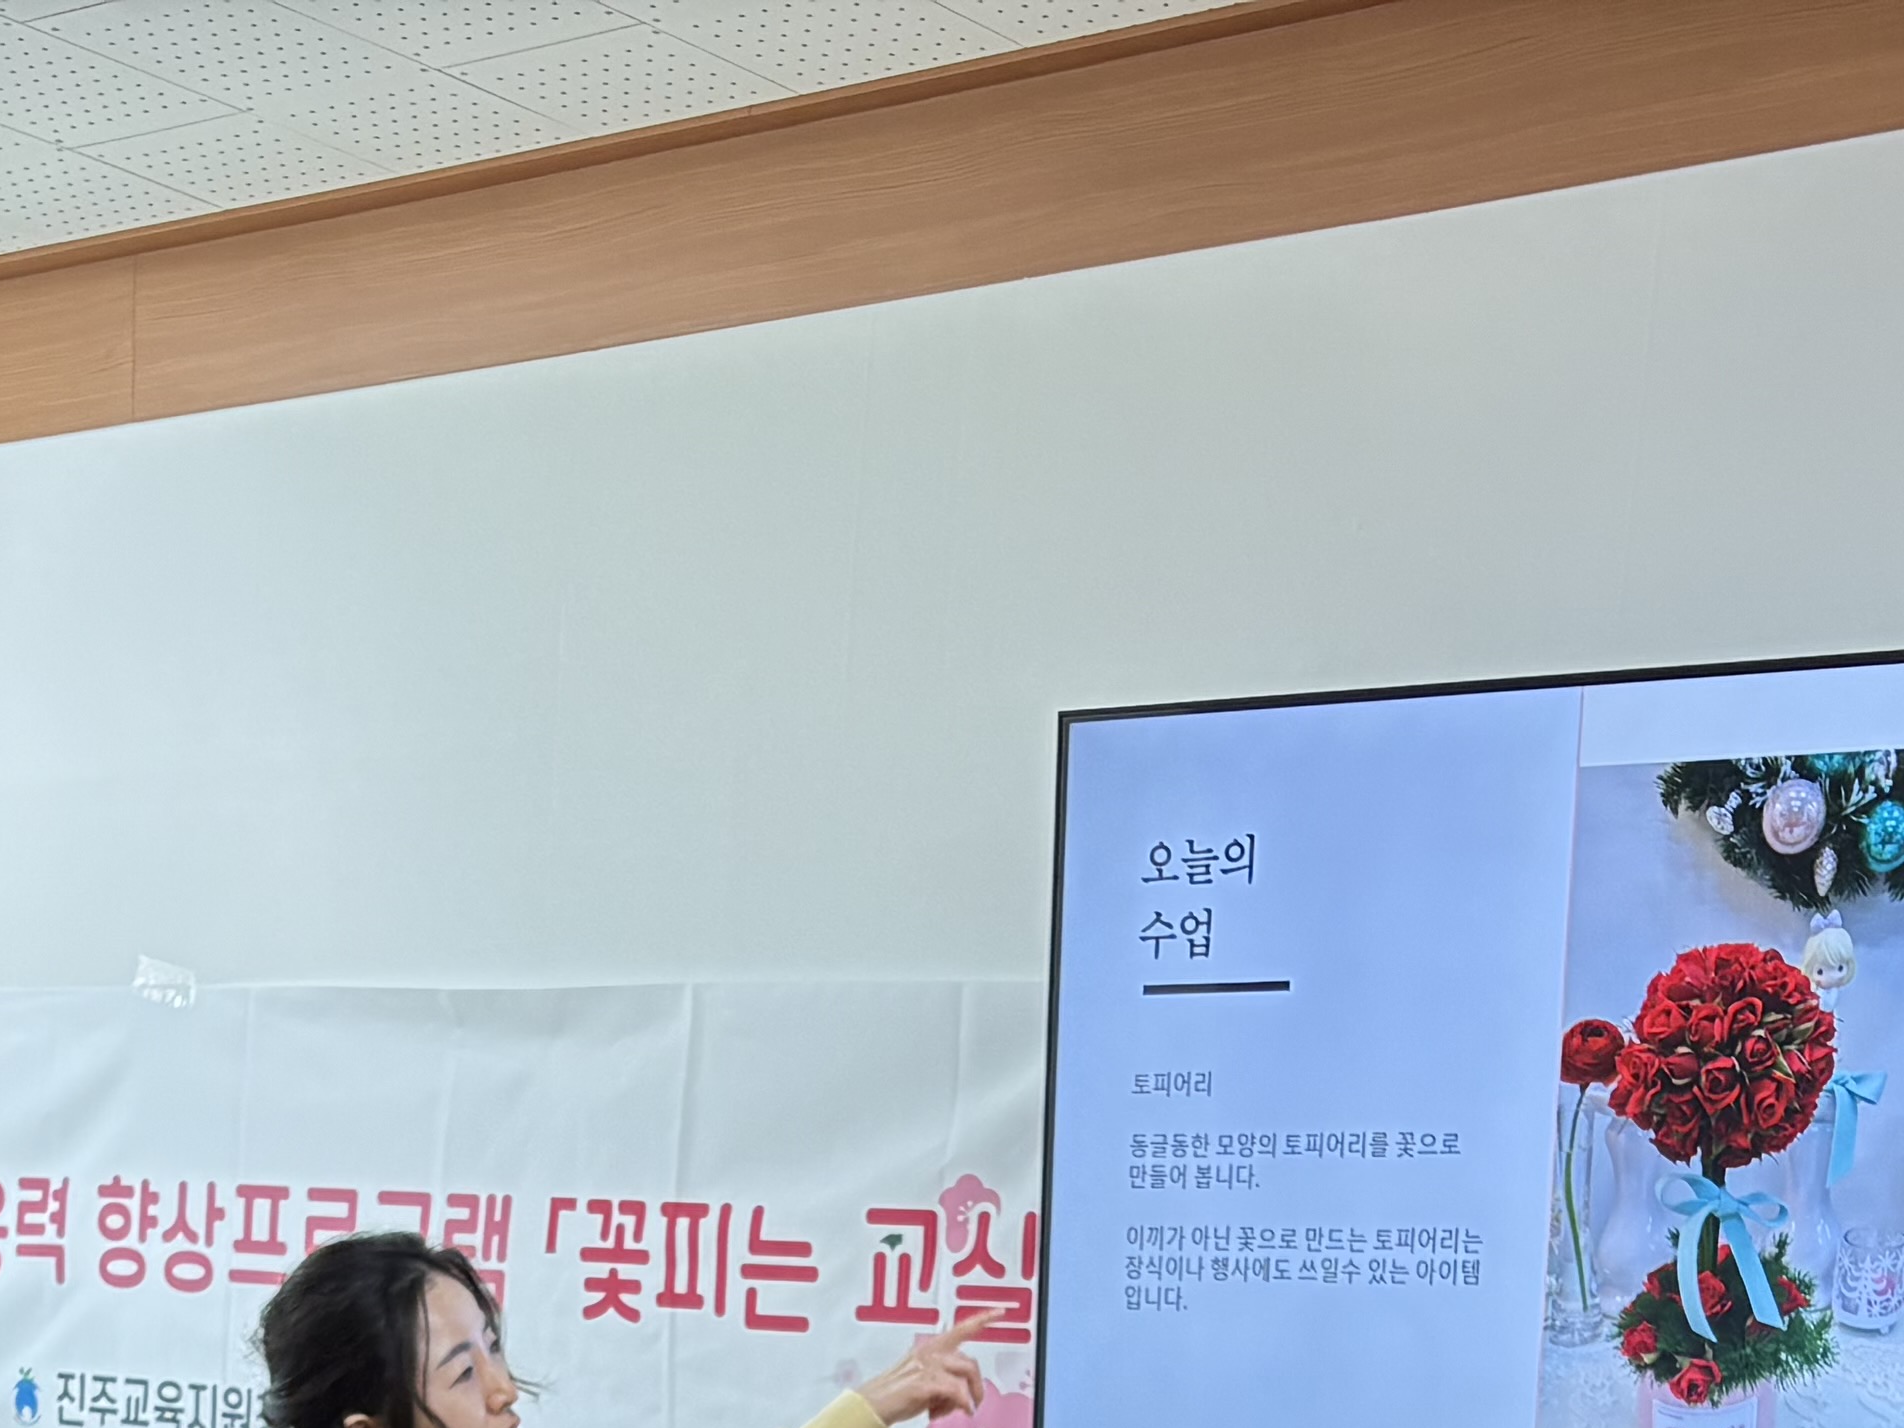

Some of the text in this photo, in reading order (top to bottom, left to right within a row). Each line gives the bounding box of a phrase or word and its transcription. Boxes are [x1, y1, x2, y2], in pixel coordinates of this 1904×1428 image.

[1141, 833, 1255, 885] 오늘의
[1139, 907, 1212, 960] 수업
[1131, 1071, 1212, 1097] 토피어리
[1129, 1131, 1461, 1159] 동글동한 모양의 토피어리를 꽃으로
[1129, 1163, 1260, 1190] 만들어 봅니다.
[1126, 1225, 1484, 1255] 이끼가 아닌 꽃으로 만드는 토피어리는
[855, 1207, 1038, 1345] 교실
[1125, 1255, 1481, 1286] 장식이나 행사에도 쓰일수 있는 아이템
[1124, 1285, 1188, 1312] 입니다.
